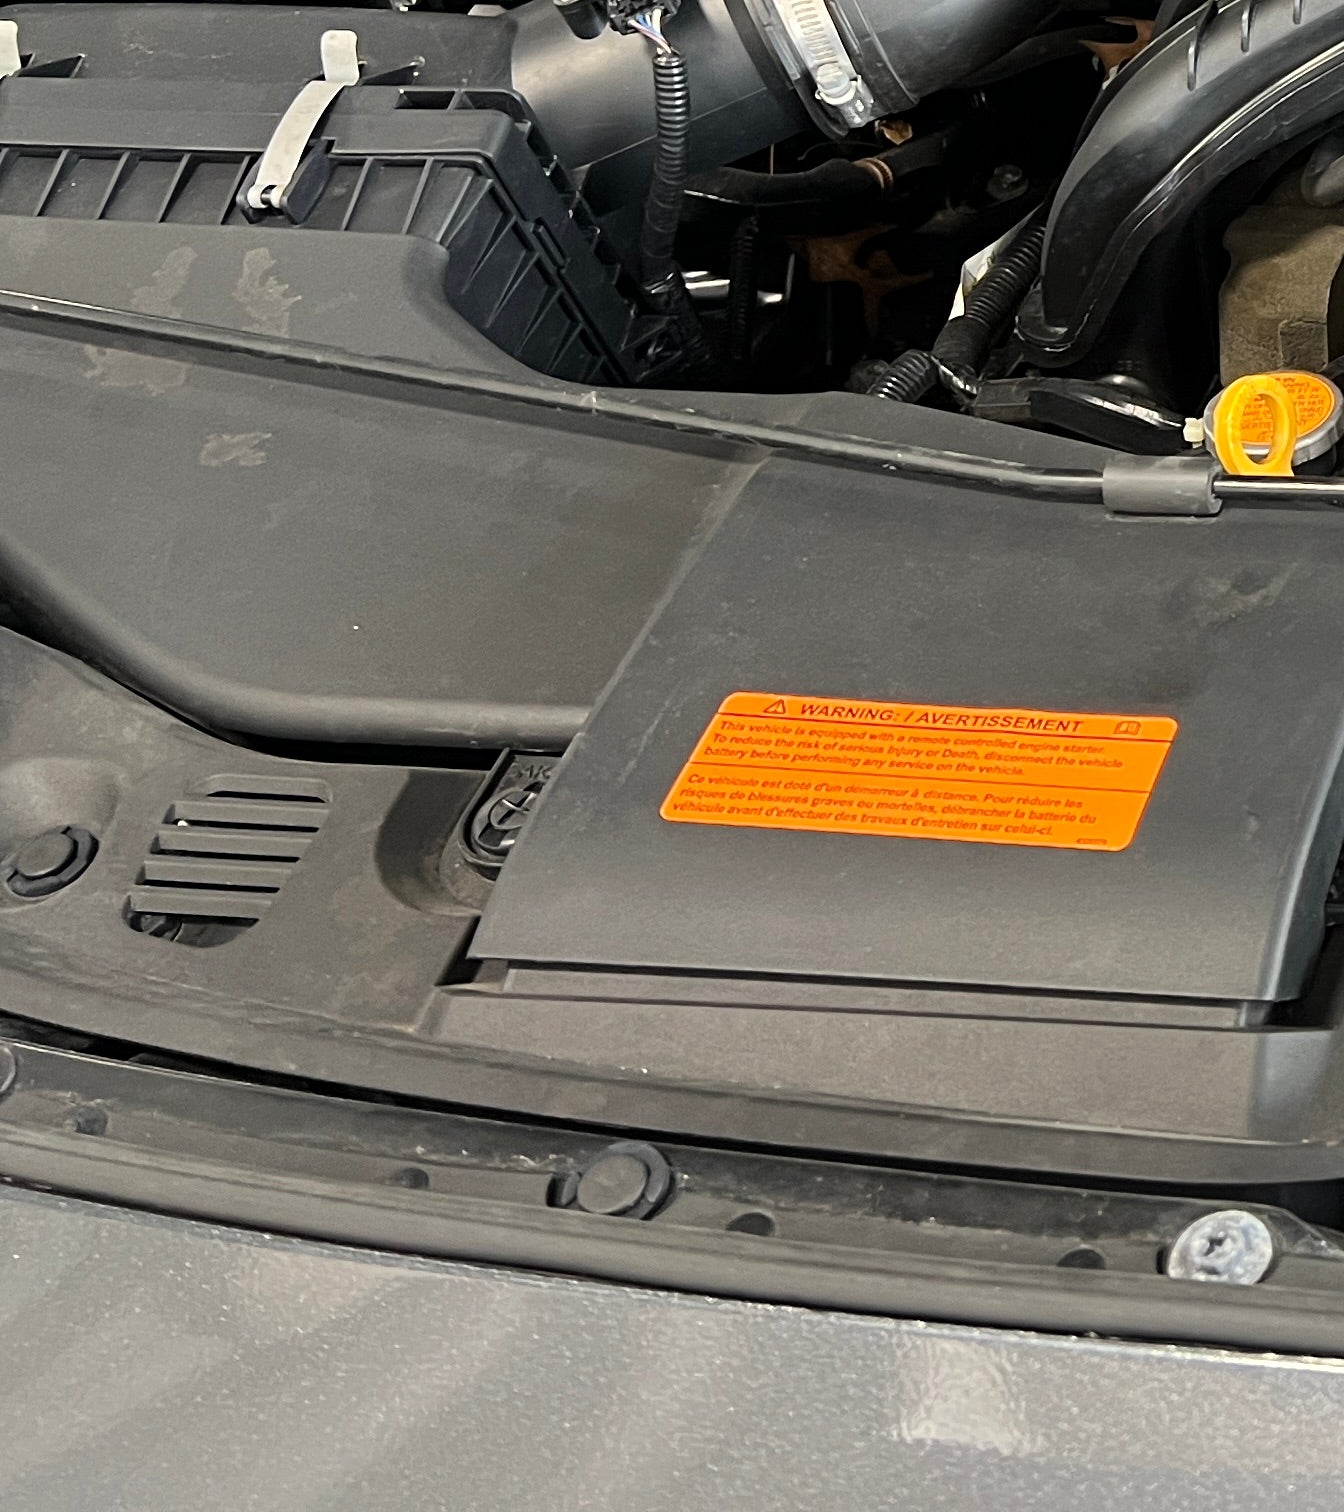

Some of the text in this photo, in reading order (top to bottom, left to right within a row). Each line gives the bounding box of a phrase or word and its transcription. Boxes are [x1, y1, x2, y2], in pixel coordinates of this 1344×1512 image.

[797, 703, 1085, 732] WARNING: / AVERTISSEMENT
